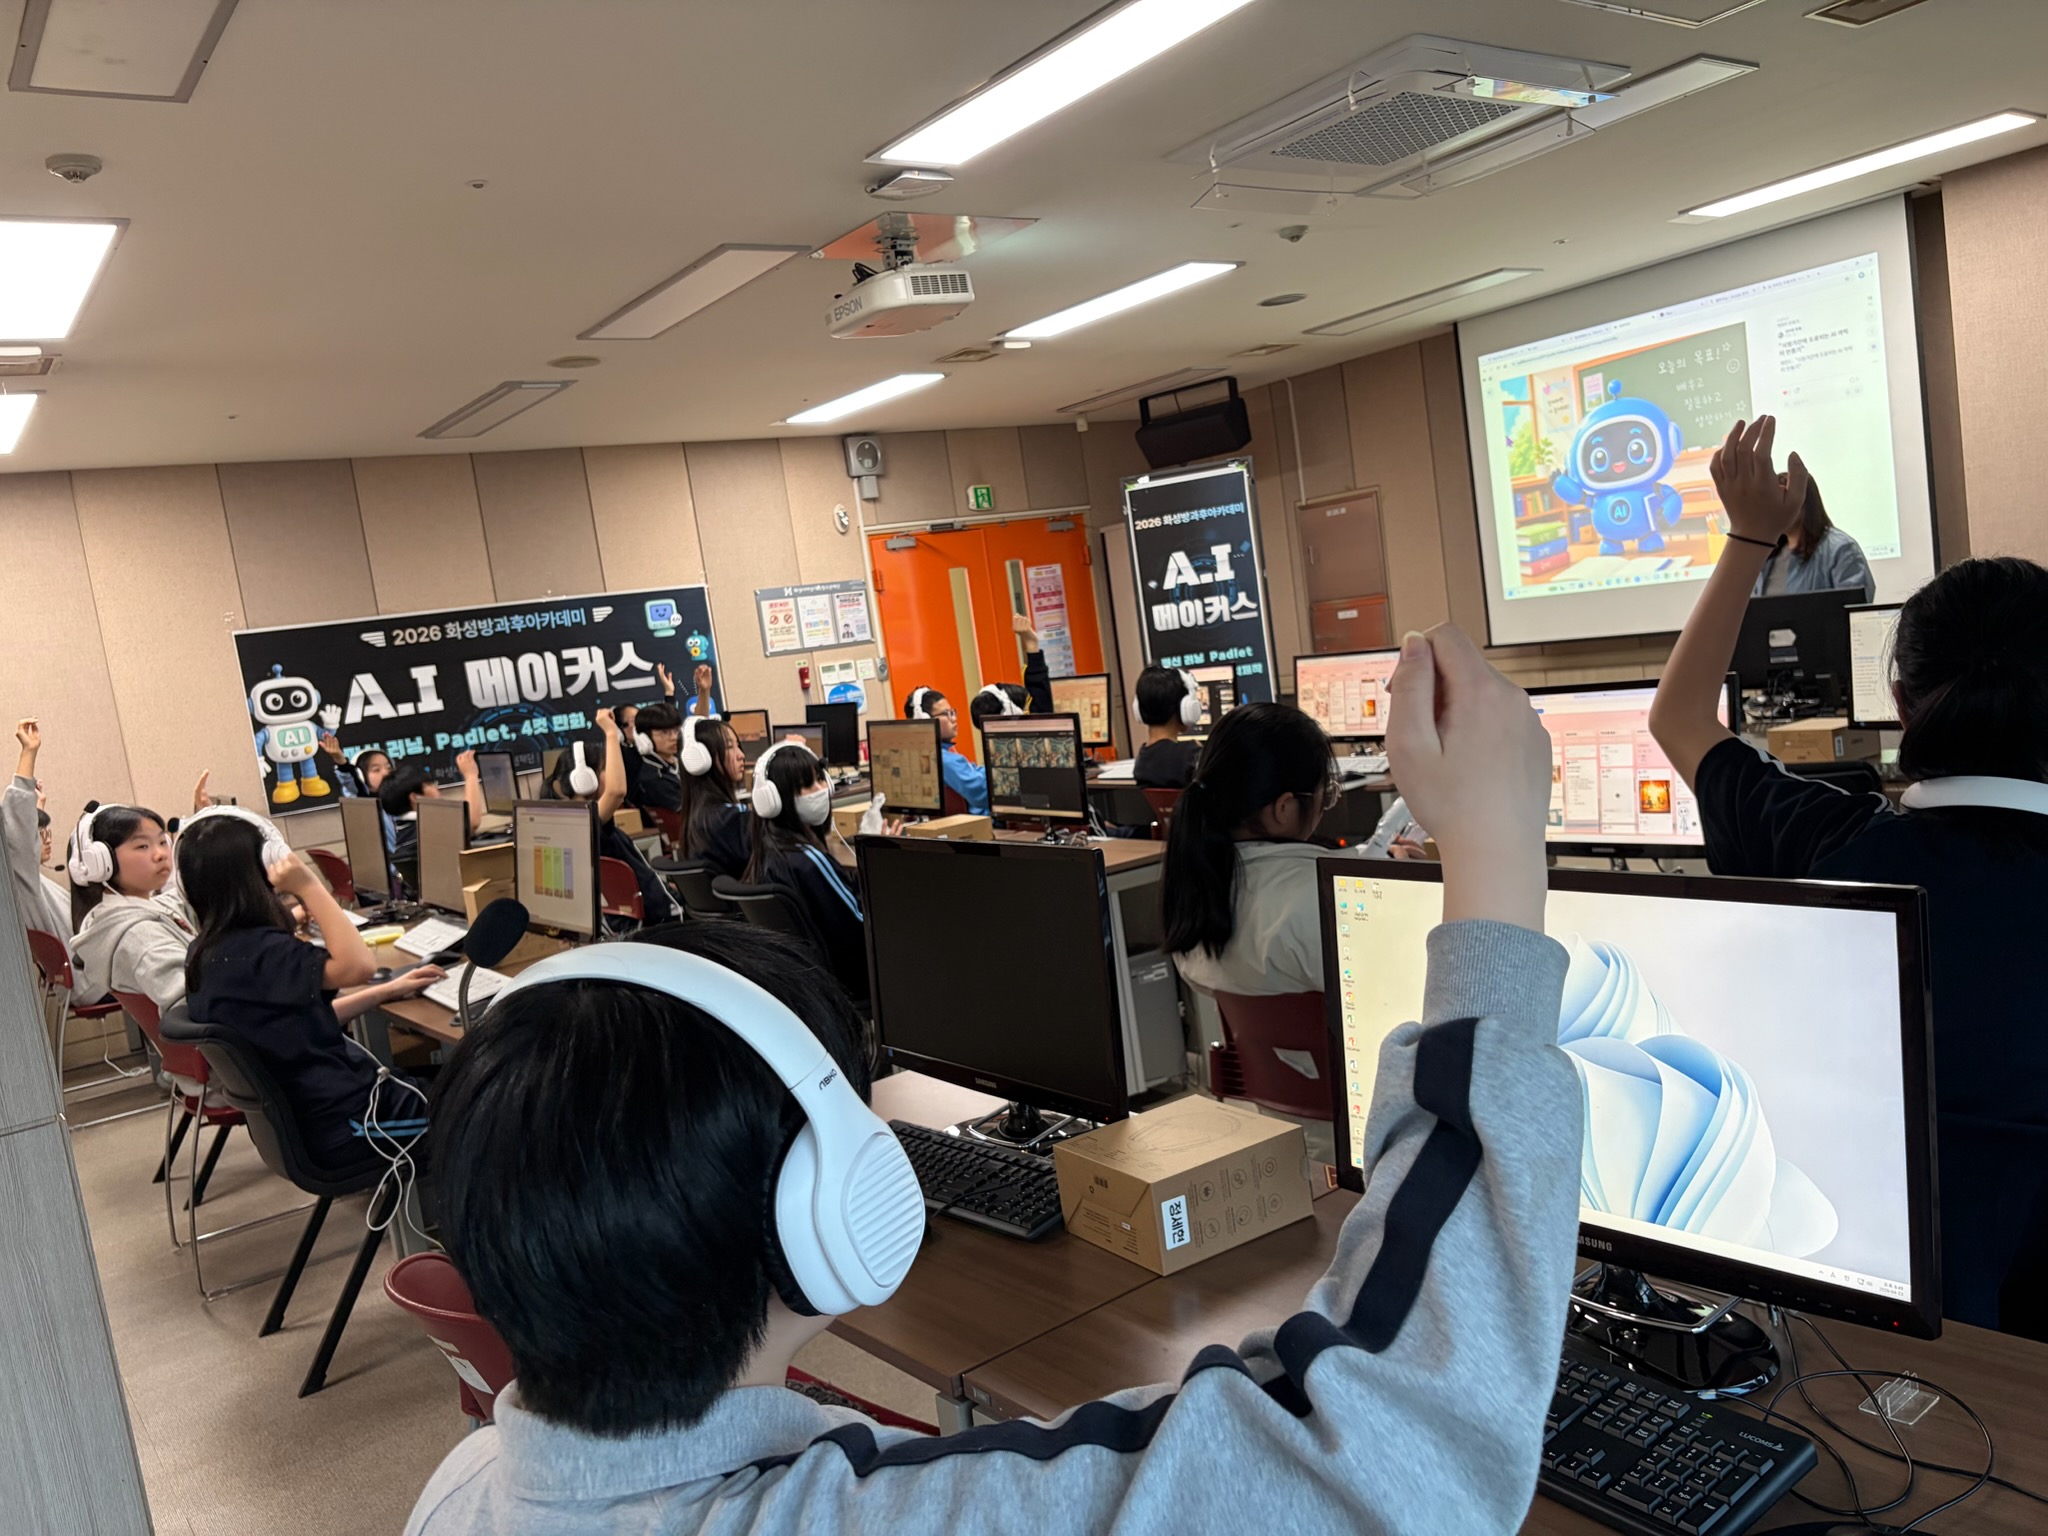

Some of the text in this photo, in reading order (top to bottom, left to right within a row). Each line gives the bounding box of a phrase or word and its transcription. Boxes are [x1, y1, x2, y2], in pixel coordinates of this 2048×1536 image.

[834, 296, 863, 321] EPSON
[1658, 347, 1720, 375] 오늘의 목표!
[1676, 377, 1705, 392] 배우고
[1134, 502, 1245, 531] 2026 화성방과후아카데미
[1614, 505, 1626, 518] AI
[1162, 543, 1236, 591] A.I
[1151, 591, 1259, 632] 메이커스
[392, 607, 587, 646] 2026 화성방과후아카데미
[1209, 646, 1254, 662] Padlet
[464, 641, 657, 710] 메이커스
[343, 664, 445, 726] A.I
[285, 729, 305, 745] AI
[435, 725, 517, 751] Padlet,
[521, 716, 549, 737] 4컷
[552, 711, 592, 732] 만화,
[1739, 1431, 1774, 1448] LUCOMS
